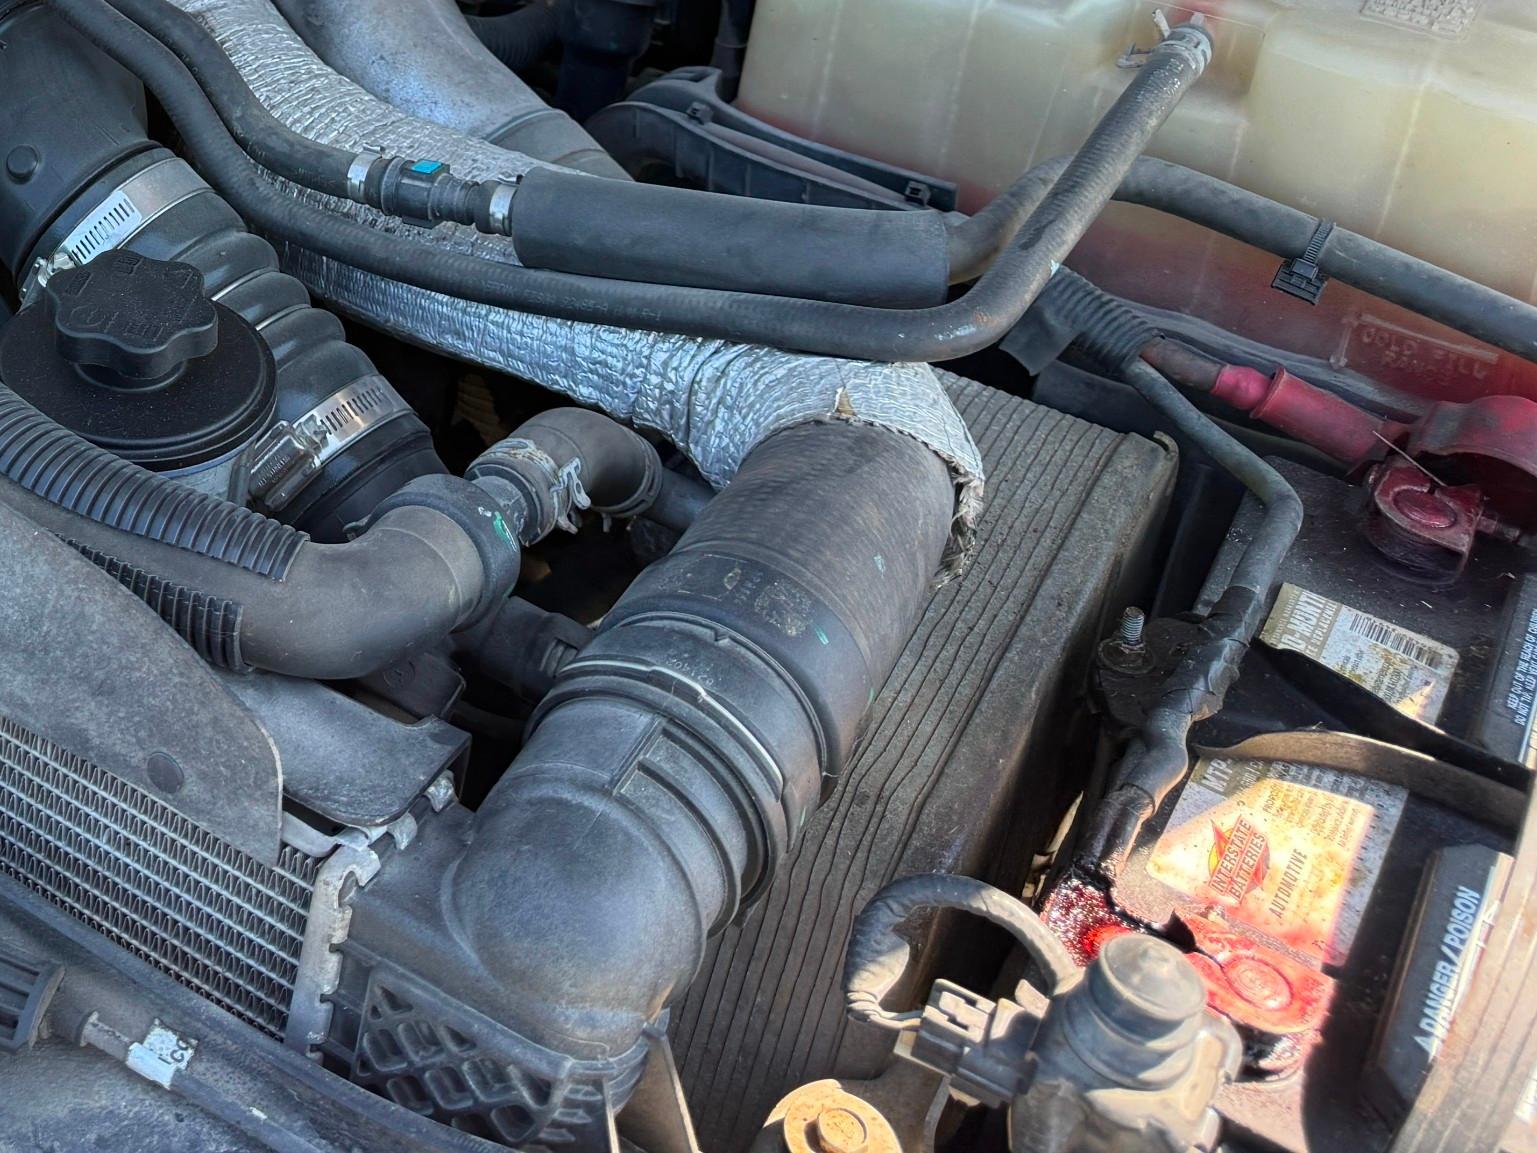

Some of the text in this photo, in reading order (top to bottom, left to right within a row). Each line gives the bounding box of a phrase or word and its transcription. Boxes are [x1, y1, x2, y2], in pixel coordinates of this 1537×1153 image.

[1210, 818, 1254, 894] INTERSTATE
[1229, 831, 1267, 901] BATTERIES
[1268, 847, 1308, 919] AUTOMOTIVE
